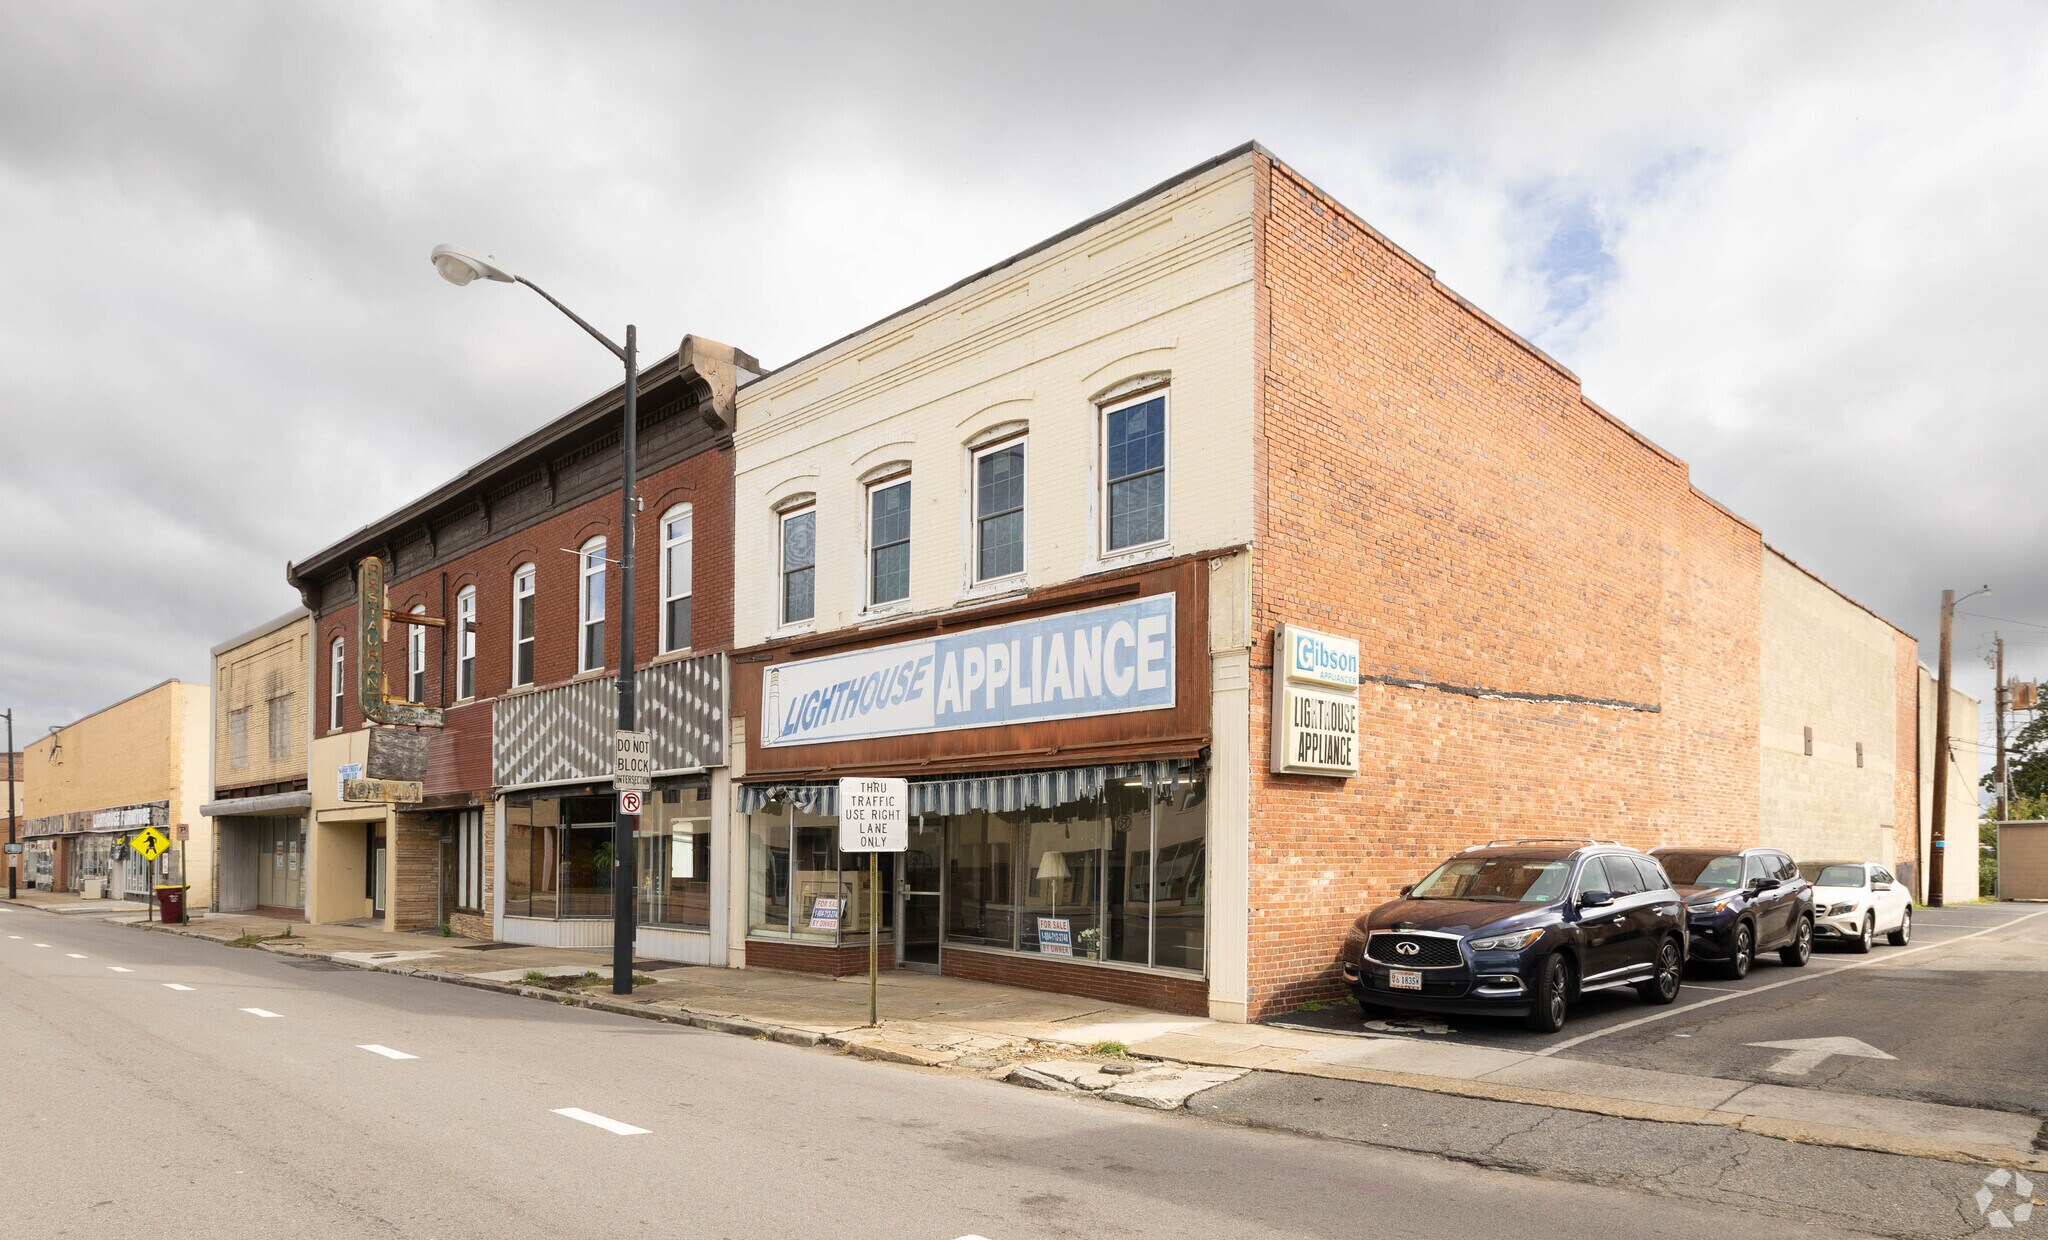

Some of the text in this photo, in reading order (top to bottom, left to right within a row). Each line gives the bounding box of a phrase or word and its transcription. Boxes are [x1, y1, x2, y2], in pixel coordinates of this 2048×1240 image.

[1296, 635, 1357, 673] Gibson
[782, 614, 1168, 736] LIGHTHOUSE APPLIANCE
[1319, 672, 1357, 684] APPLIANCES
[617, 739, 649, 753] DO NOT
[1298, 731, 1352, 766] APPLIANCE
[617, 758, 649, 772] BLOCK
[616, 775, 650, 785] INTERSECTION
[861, 782, 887, 793] THRU
[851, 796, 895, 806] TRAFFIC
[845, 809, 901, 820] USE RIGHT
[860, 823, 888, 834] LANE
[860, 837, 887, 847] ONLY
[1040, 920, 1067, 930] FOR SALE
[1051, 945, 1069, 954] OWNER
